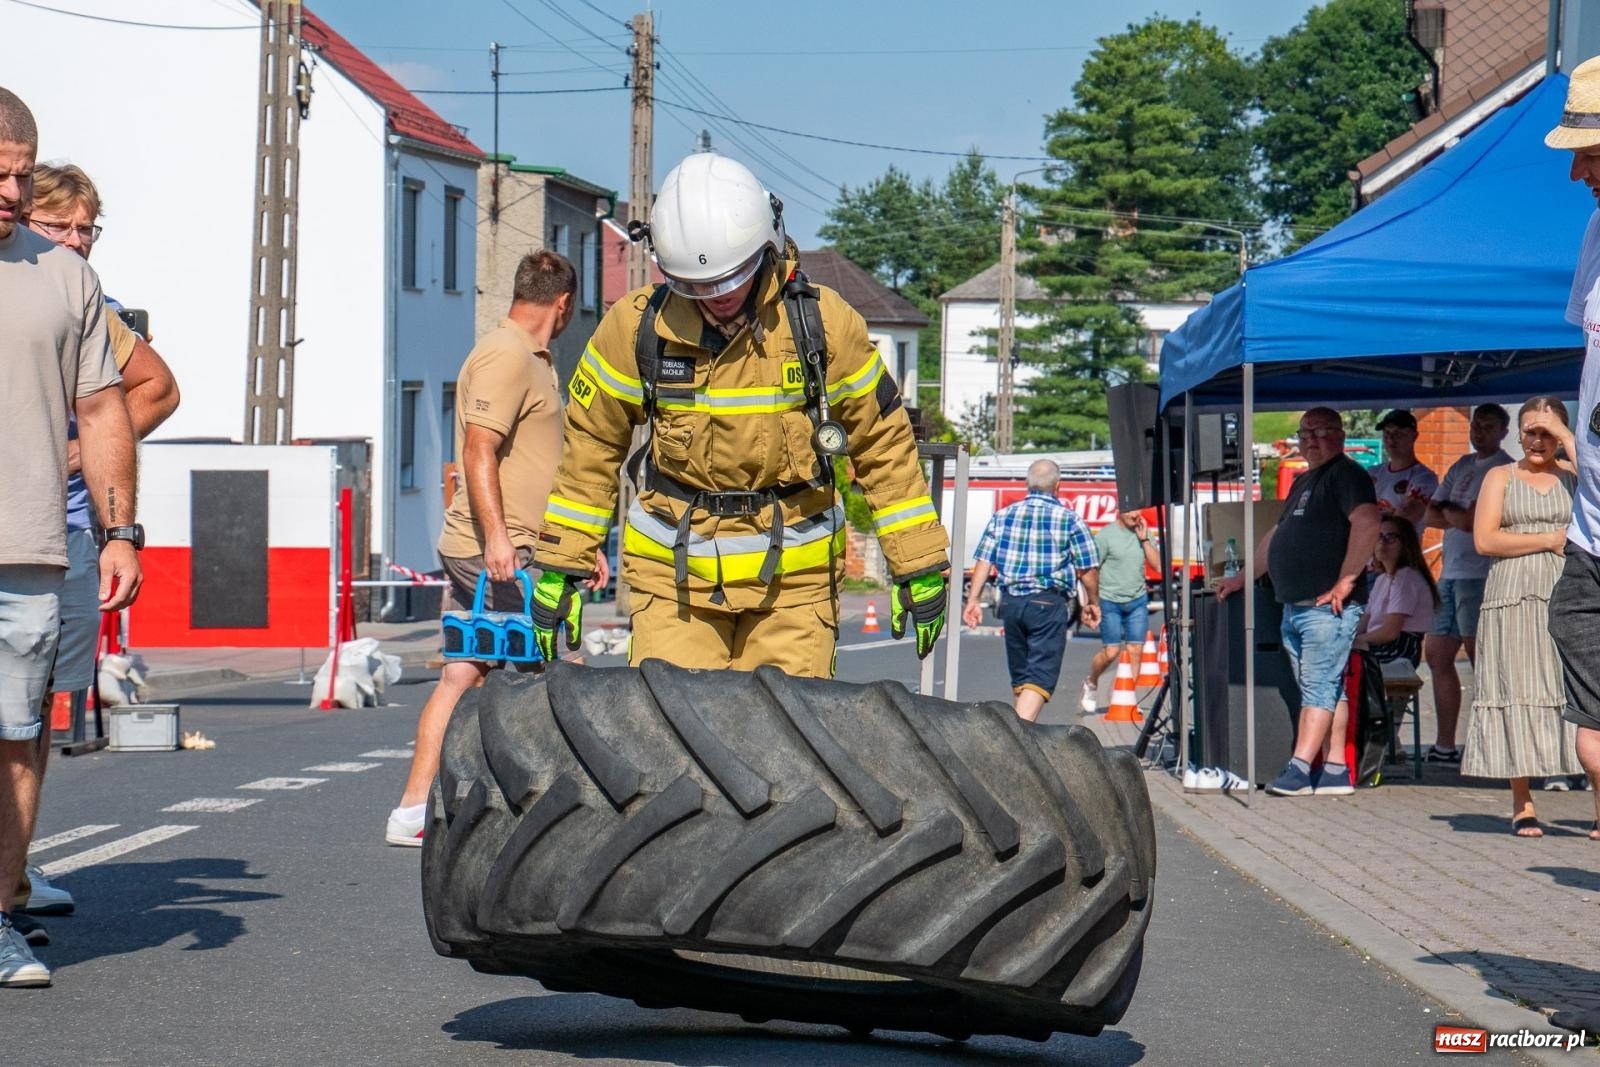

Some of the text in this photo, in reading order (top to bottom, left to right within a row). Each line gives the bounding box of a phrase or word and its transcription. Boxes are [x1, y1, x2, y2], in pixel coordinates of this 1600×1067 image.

[698, 254, 707, 265] 6
[662, 360, 685, 369] TOBIASZ
[787, 366, 804, 384] OS
[571, 374, 592, 400] OSP
[1072, 494, 1117, 522] 112
